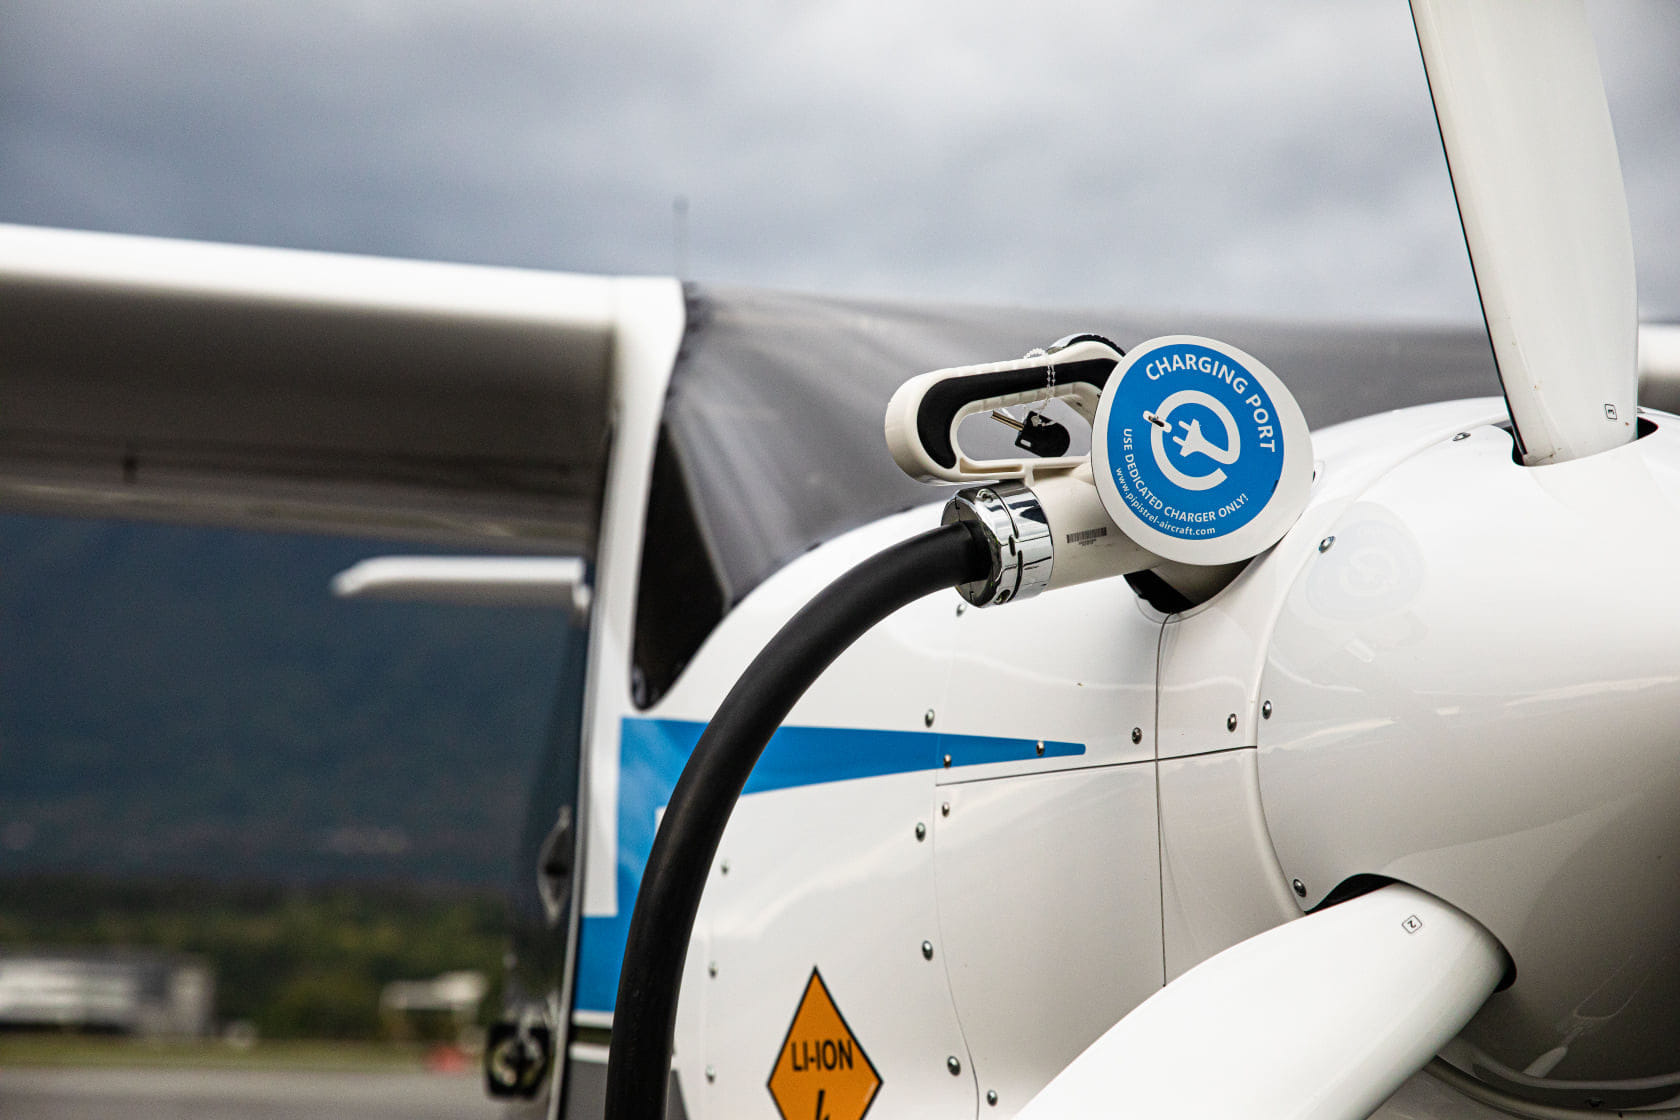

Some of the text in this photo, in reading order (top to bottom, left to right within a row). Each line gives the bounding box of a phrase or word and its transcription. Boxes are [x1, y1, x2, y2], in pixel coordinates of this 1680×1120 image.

[1145, 354, 1276, 453] CHARGING PORT
[1115, 467, 1216, 536] www.pipistrel-aircraft.com
[1123, 428, 1249, 523] USE DEDICATED CHARGER ONLY!
[791, 1039, 854, 1072] LI-ION
